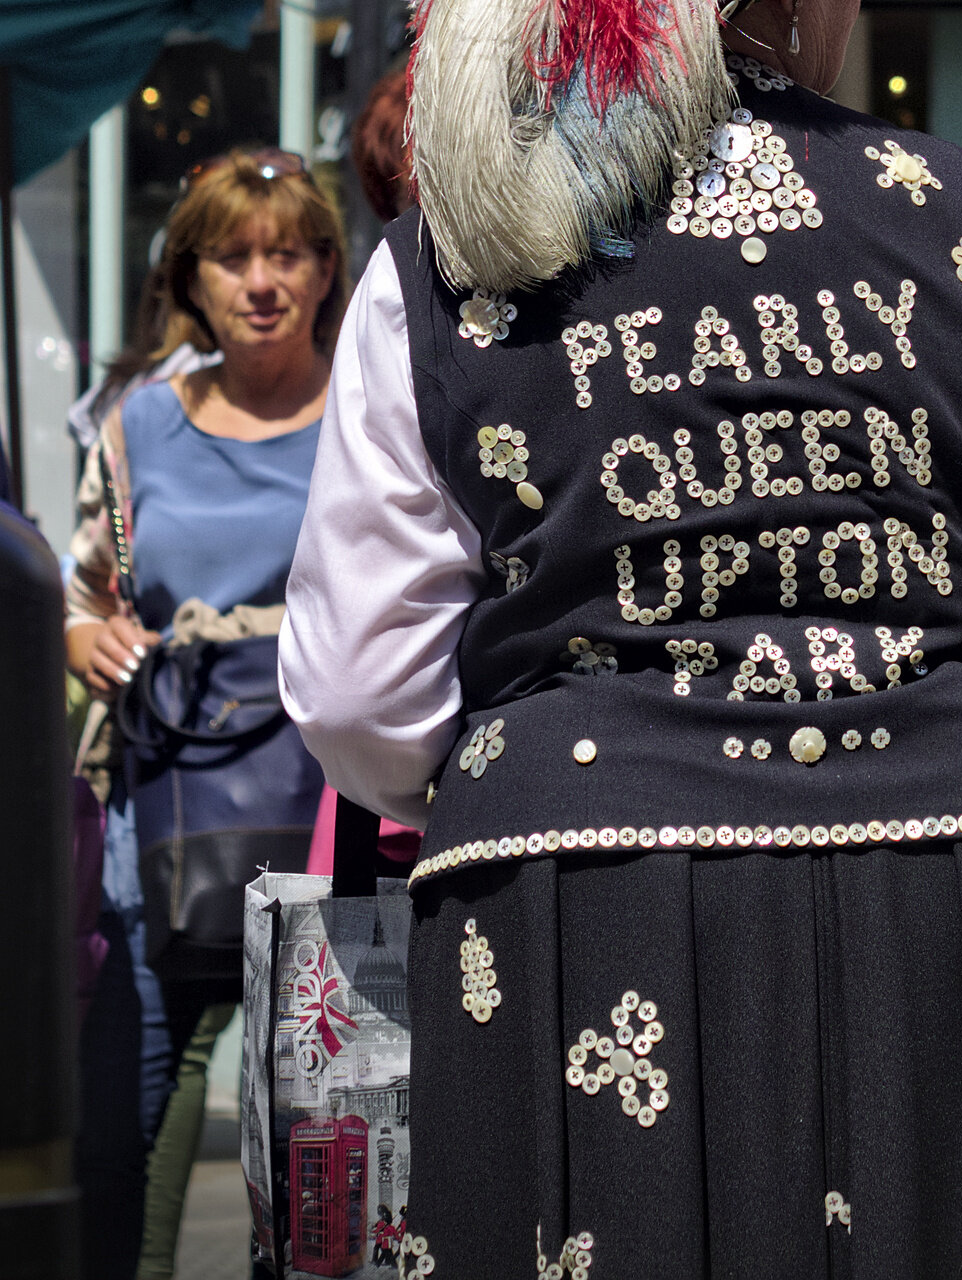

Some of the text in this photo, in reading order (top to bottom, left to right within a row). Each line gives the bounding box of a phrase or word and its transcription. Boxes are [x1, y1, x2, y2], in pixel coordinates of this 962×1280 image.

[561, 279, 917, 409] PEARLY
[601, 407, 932, 522] QUEEN
[613, 513, 954, 625] UPTON
[290, 907, 323, 1110] LONDON
